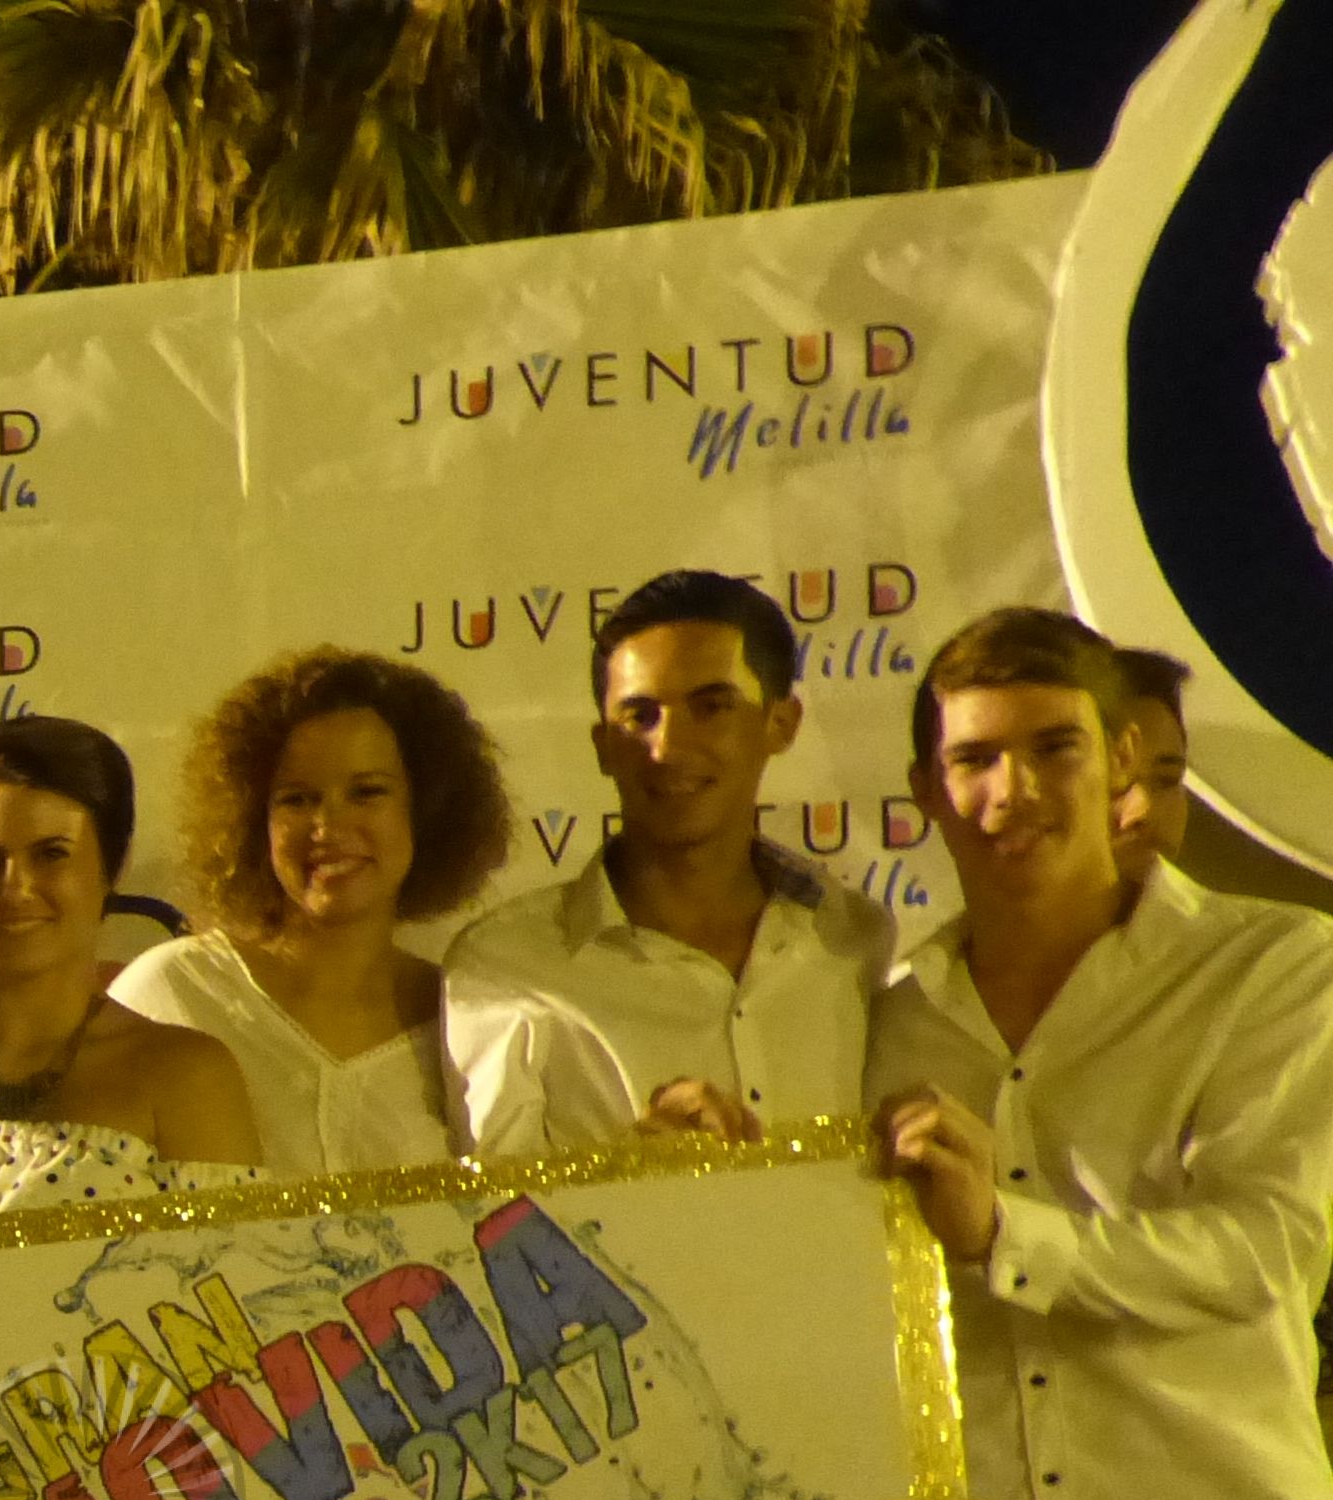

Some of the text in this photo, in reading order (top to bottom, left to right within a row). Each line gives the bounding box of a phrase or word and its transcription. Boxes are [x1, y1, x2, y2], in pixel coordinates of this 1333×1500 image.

[399, 324, 915, 426] JUVENTUD
[687, 387, 910, 481] Melilla
[401, 562, 917, 654] JUVEUD
